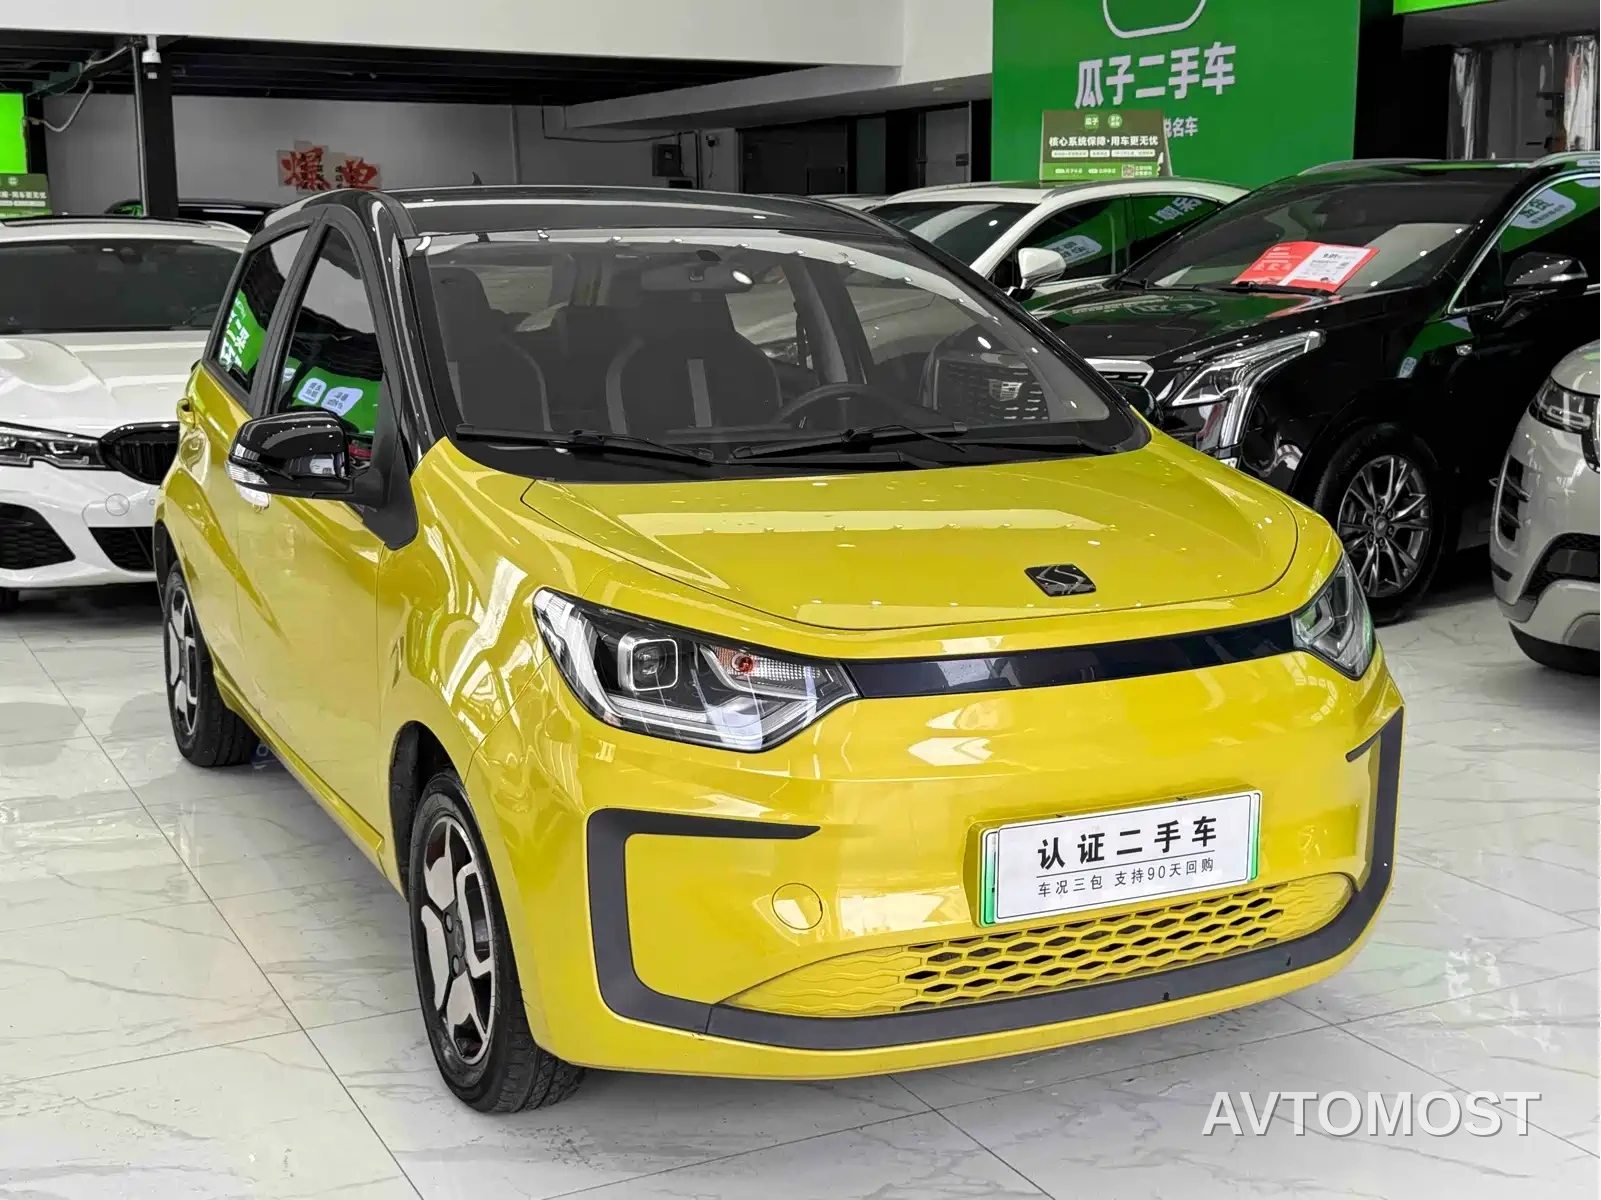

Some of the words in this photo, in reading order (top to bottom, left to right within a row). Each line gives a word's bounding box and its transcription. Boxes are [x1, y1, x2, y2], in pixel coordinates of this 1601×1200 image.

[1075, 42, 1236, 109] 瓜子二手车
[1037, 816, 1217, 870] 认证二手车
[1038, 874, 1103, 898] 车况三包
[1114, 857, 1214, 886] 支持90天回购
